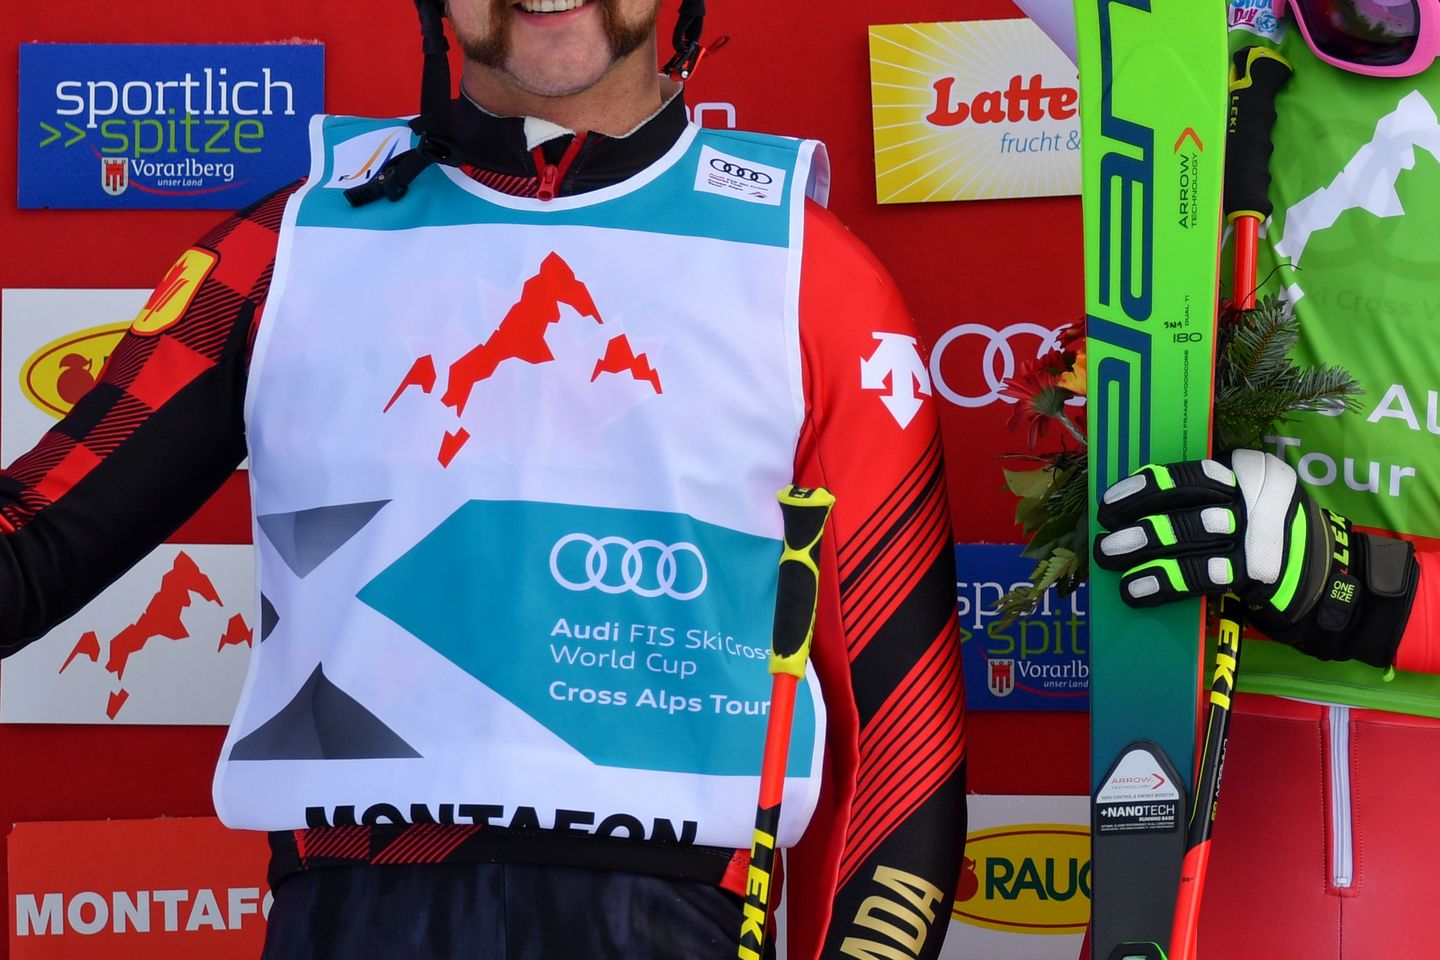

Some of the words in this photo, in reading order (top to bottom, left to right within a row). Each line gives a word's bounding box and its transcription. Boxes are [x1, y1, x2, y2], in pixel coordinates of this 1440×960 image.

[56, 68, 295, 129] sportlich
[925, 73, 1079, 128] Latte
[1229, 95, 1239, 133] LEKI
[101, 109, 265, 158] spitze
[1000, 131, 1061, 154] frucht
[132, 159, 235, 182] Vorarlberg
[157, 179, 180, 187] unser
[182, 178, 204, 187] Land
[1179, 154, 1189, 229] ARROW
[1173, 332, 1203, 343] 180
[1264, 435, 1416, 497] Tour
[1330, 509, 1349, 566] LEK
[1330, 589, 1353, 603] SIZE
[1333, 580, 1355, 594] ONE
[551, 617, 619, 642] Audi
[629, 623, 675, 647] FIS
[685, 628, 723, 652] Ski
[725, 635, 771, 661] Cross
[987, 610, 1087, 659] spit
[550, 644, 636, 670] World
[645, 654, 698, 680] Cup
[1018, 659, 1089, 679] Vorarlb
[549, 681, 628, 707] Cross
[635, 689, 703, 715] Alps
[709, 693, 772, 717] Tour
[1043, 680, 1069, 689] unser
[1071, 679, 1089, 688] Land
[1111, 776, 1152, 785] ARROW
[15, 887, 272, 937] MONTAF
